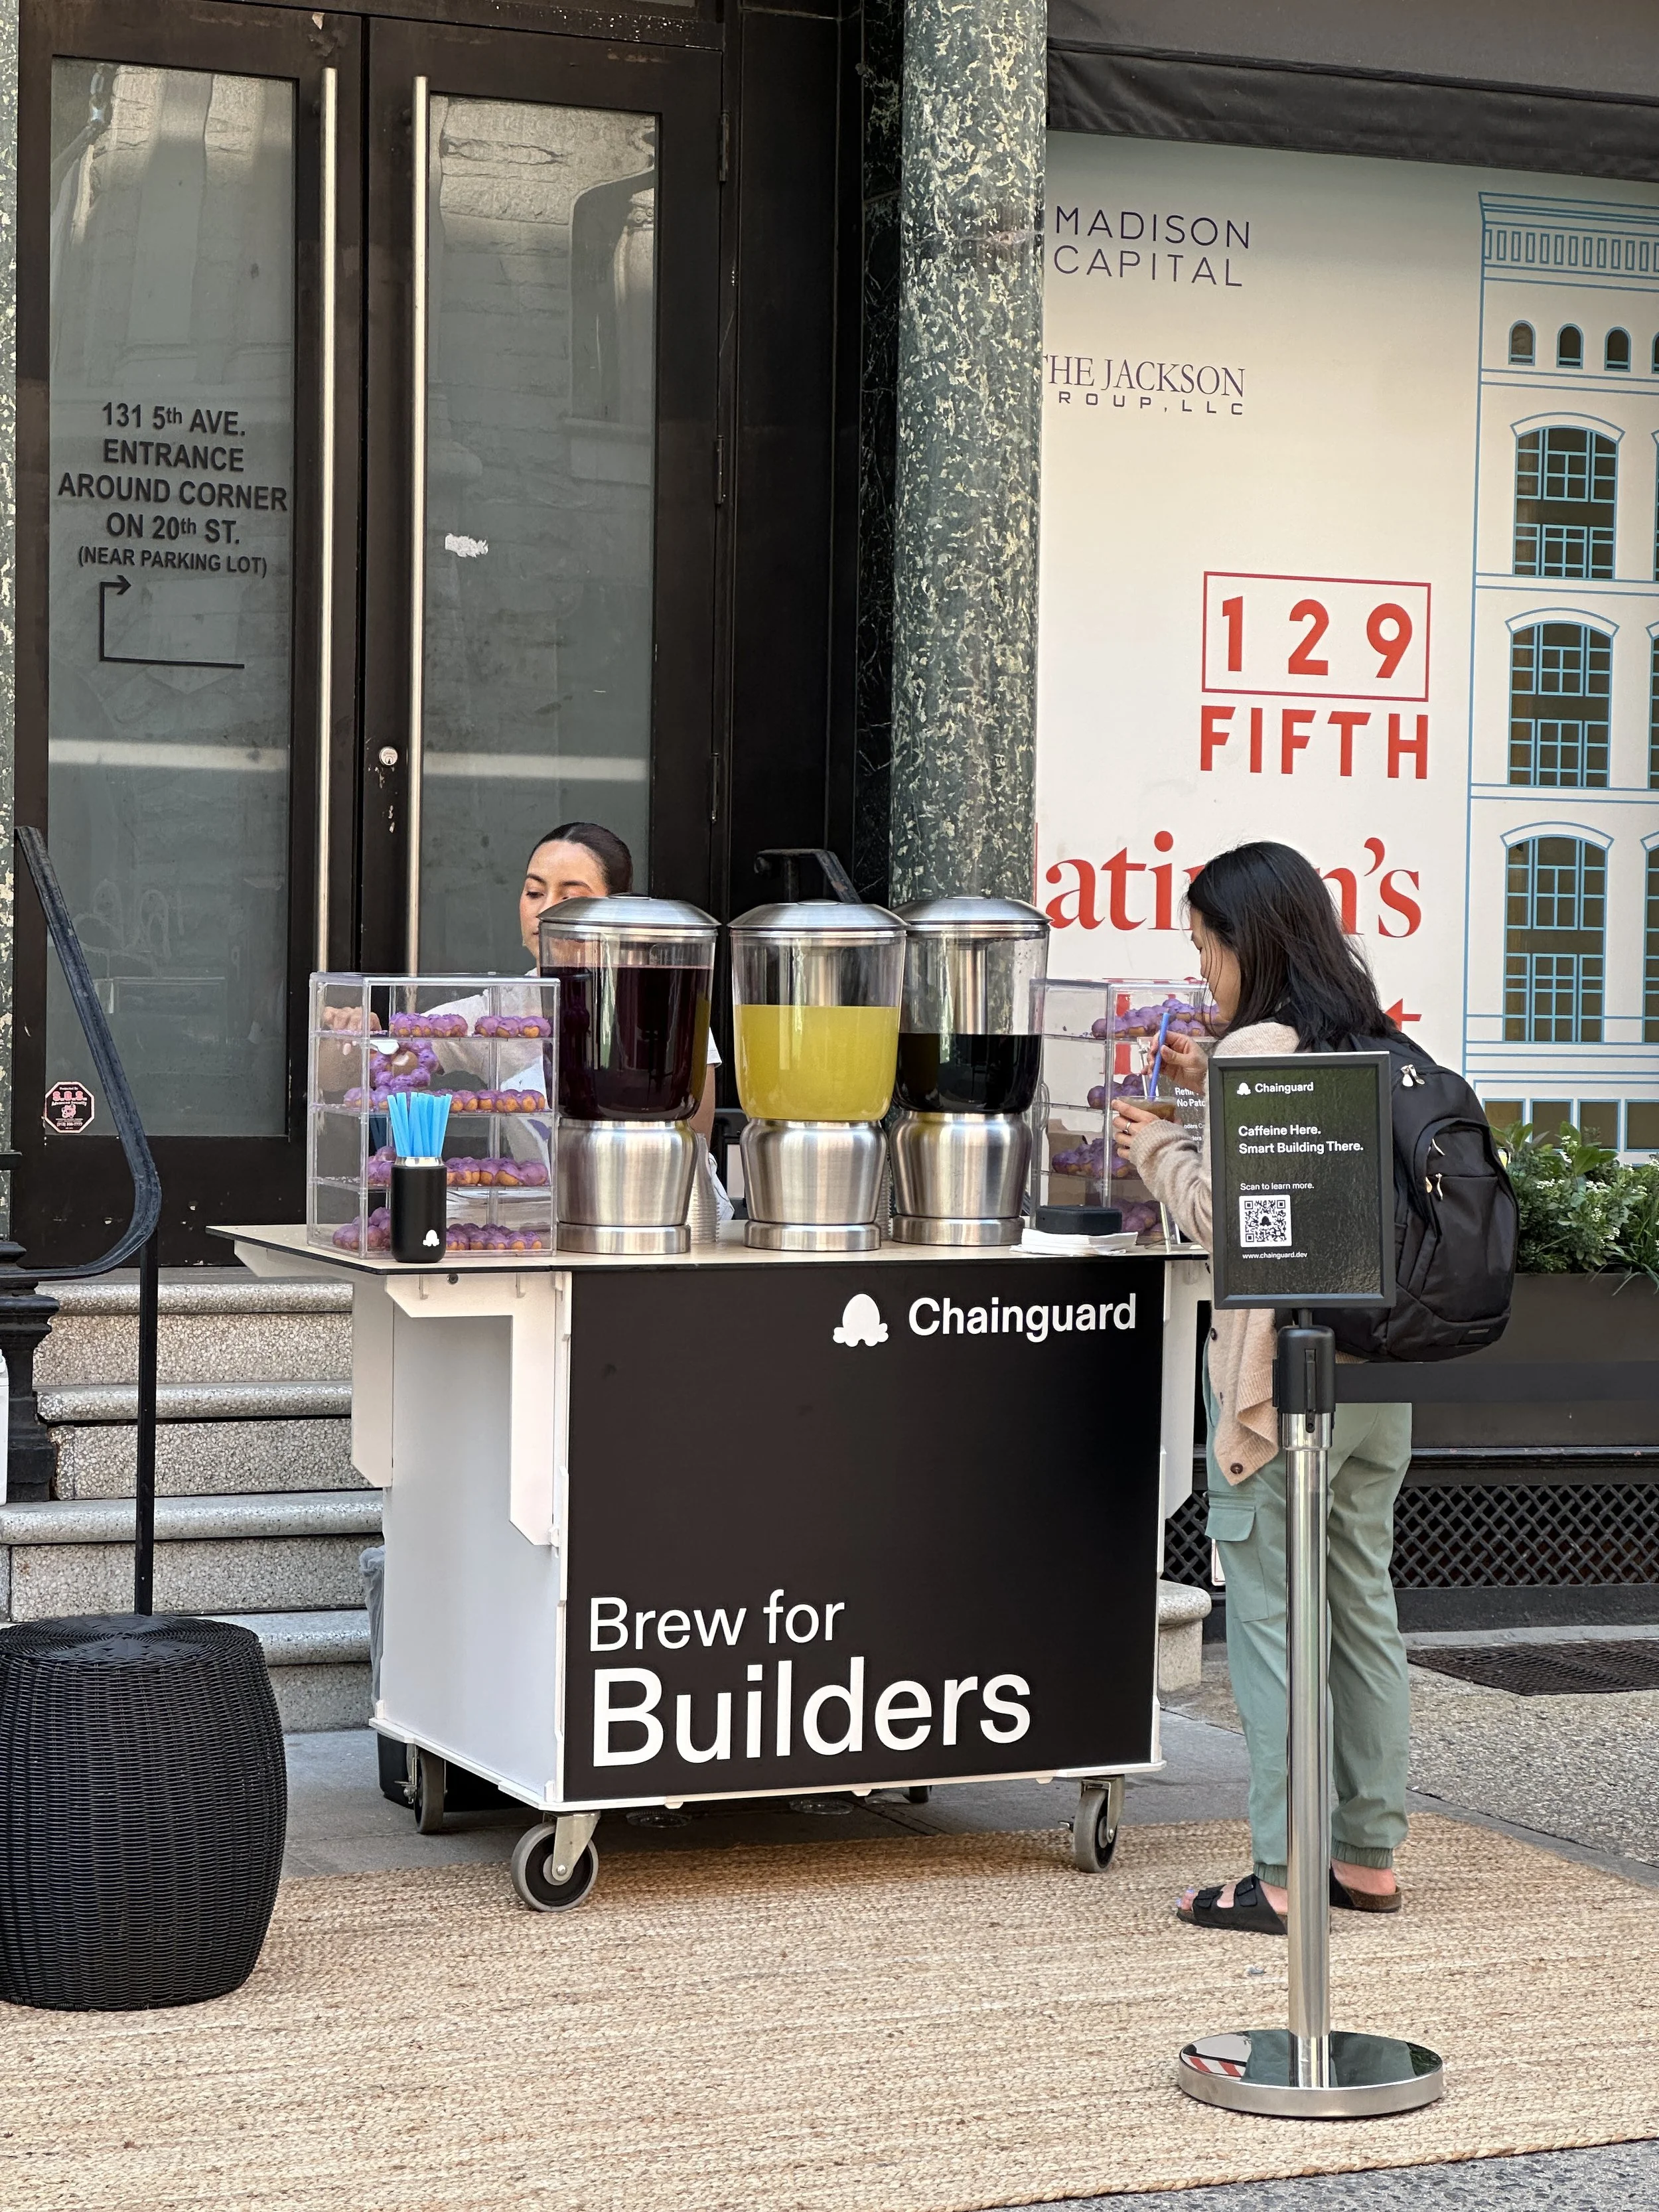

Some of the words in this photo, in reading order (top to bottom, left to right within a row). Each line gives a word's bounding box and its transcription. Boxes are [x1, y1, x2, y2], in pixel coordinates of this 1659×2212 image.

[1056, 206, 1250, 249] MADISON
[1054, 245, 1242, 287] CAPITAL
[1101, 358, 1246, 398] JACKSON
[102, 402, 141, 428] 131
[153, 406, 182, 430] 5th
[190, 409, 246, 436] AVE.
[103, 439, 244, 472] ENTRANCE
[58, 473, 171, 503] AROUND
[179, 480, 287, 511] CORNER
[106, 512, 143, 538] ON
[152, 516, 196, 540] 20th
[205, 520, 240, 544] ST.
[78, 546, 135, 567] (NEAR
[141, 550, 221, 571] PARKING
[226, 556, 267, 578] LOT)
[1200, 705, 1428, 779] FIFTH
[1255, 1082, 1314, 1094] Chainguard
[1238, 1125, 1287, 1137] Caffeine
[1290, 1124, 1321, 1136] Here.
[1239, 1142, 1275, 1154] Smart
[1277, 1142, 1325, 1155] Building
[1326, 1141, 1364, 1152] There.
[1242, 1251, 1307, 1260] www.chainguard.dev
[908, 1292, 1136, 1343] Chainguard
[589, 1595, 747, 1653] Brew
[763, 1589, 845, 1644] for
[593, 1655, 1031, 1768] Builders
